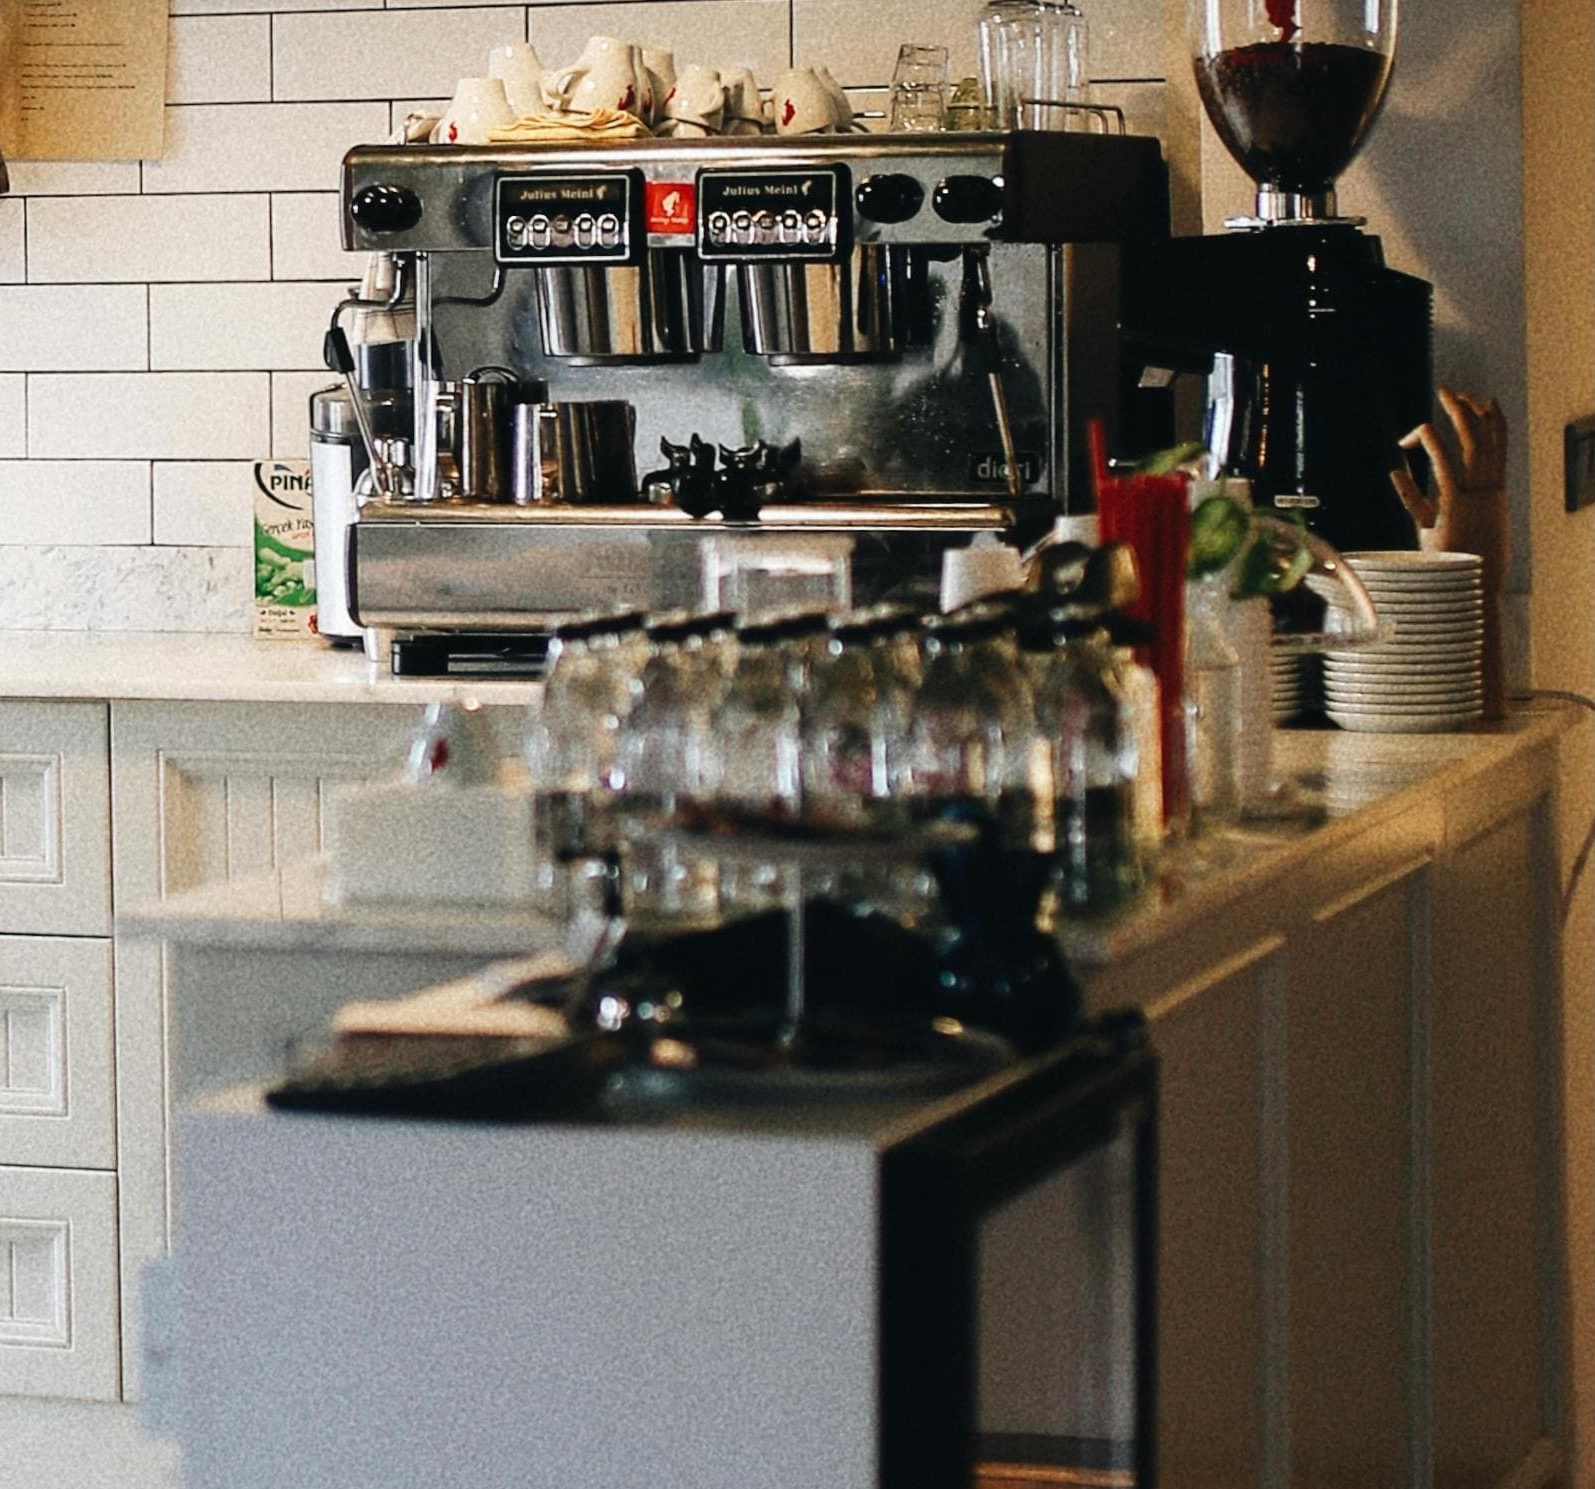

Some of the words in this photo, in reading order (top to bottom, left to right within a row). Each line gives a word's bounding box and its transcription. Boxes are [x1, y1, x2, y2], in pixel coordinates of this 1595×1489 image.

[520, 189, 557, 200] Julius
[560, 188, 593, 199] Meinl
[722, 186, 761, 196] Julius
[764, 185, 798, 195] Meinl
